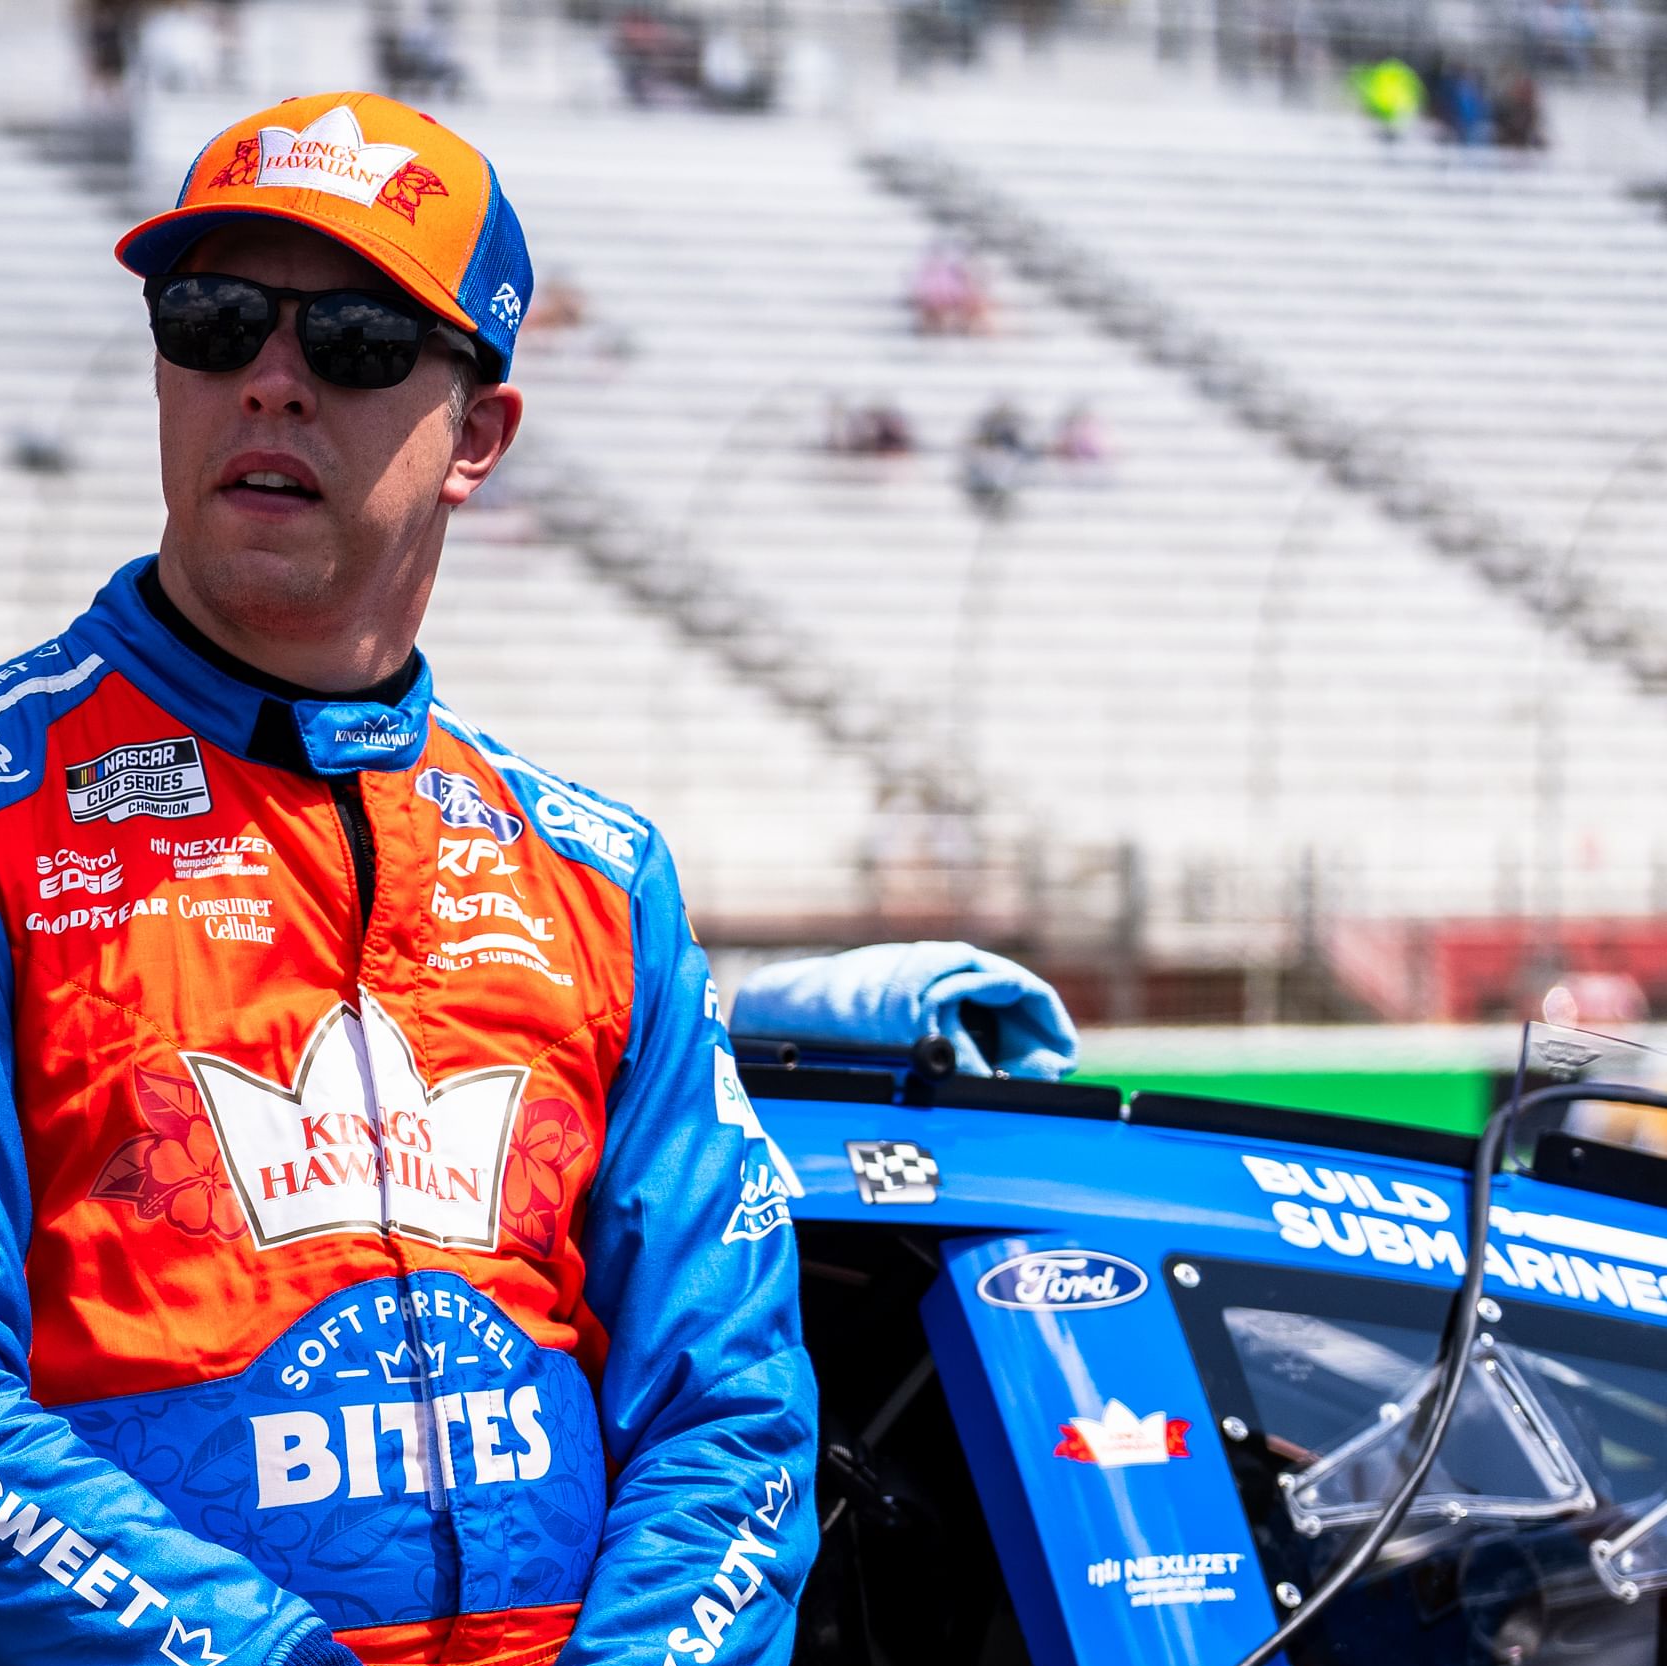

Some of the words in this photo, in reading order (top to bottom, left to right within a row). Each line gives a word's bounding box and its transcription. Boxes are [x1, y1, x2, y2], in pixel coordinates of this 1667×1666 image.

[290, 140, 359, 163] KING'S
[265, 155, 373, 186] HAWAIIAN
[103, 745, 177, 775] NASCAR
[87, 780, 120, 807] CUP
[123, 772, 184, 792] SERIES
[128, 801, 190, 816] CHAMPION
[174, 836, 275, 857] NEXLIZET
[39, 864, 124, 899] EDGE
[26, 897, 169, 935] GOODYEAR
[178, 894, 273, 918] Consumer
[204, 916, 276, 944] Cellular
[426, 952, 473, 972] BUILD
[300, 1105, 433, 1153] KING'S
[258, 1151, 484, 1203] HAWAIIAN
[1241, 1154, 1451, 1223] BUILD
[1271, 1200, 1667, 1317] SUBMARINE
[1018, 1256, 1120, 1304] Ford
[281, 1303, 364, 1391] SOFT
[249, 1385, 552, 1511] BITES
[667, 1516, 777, 1664] SALTY
